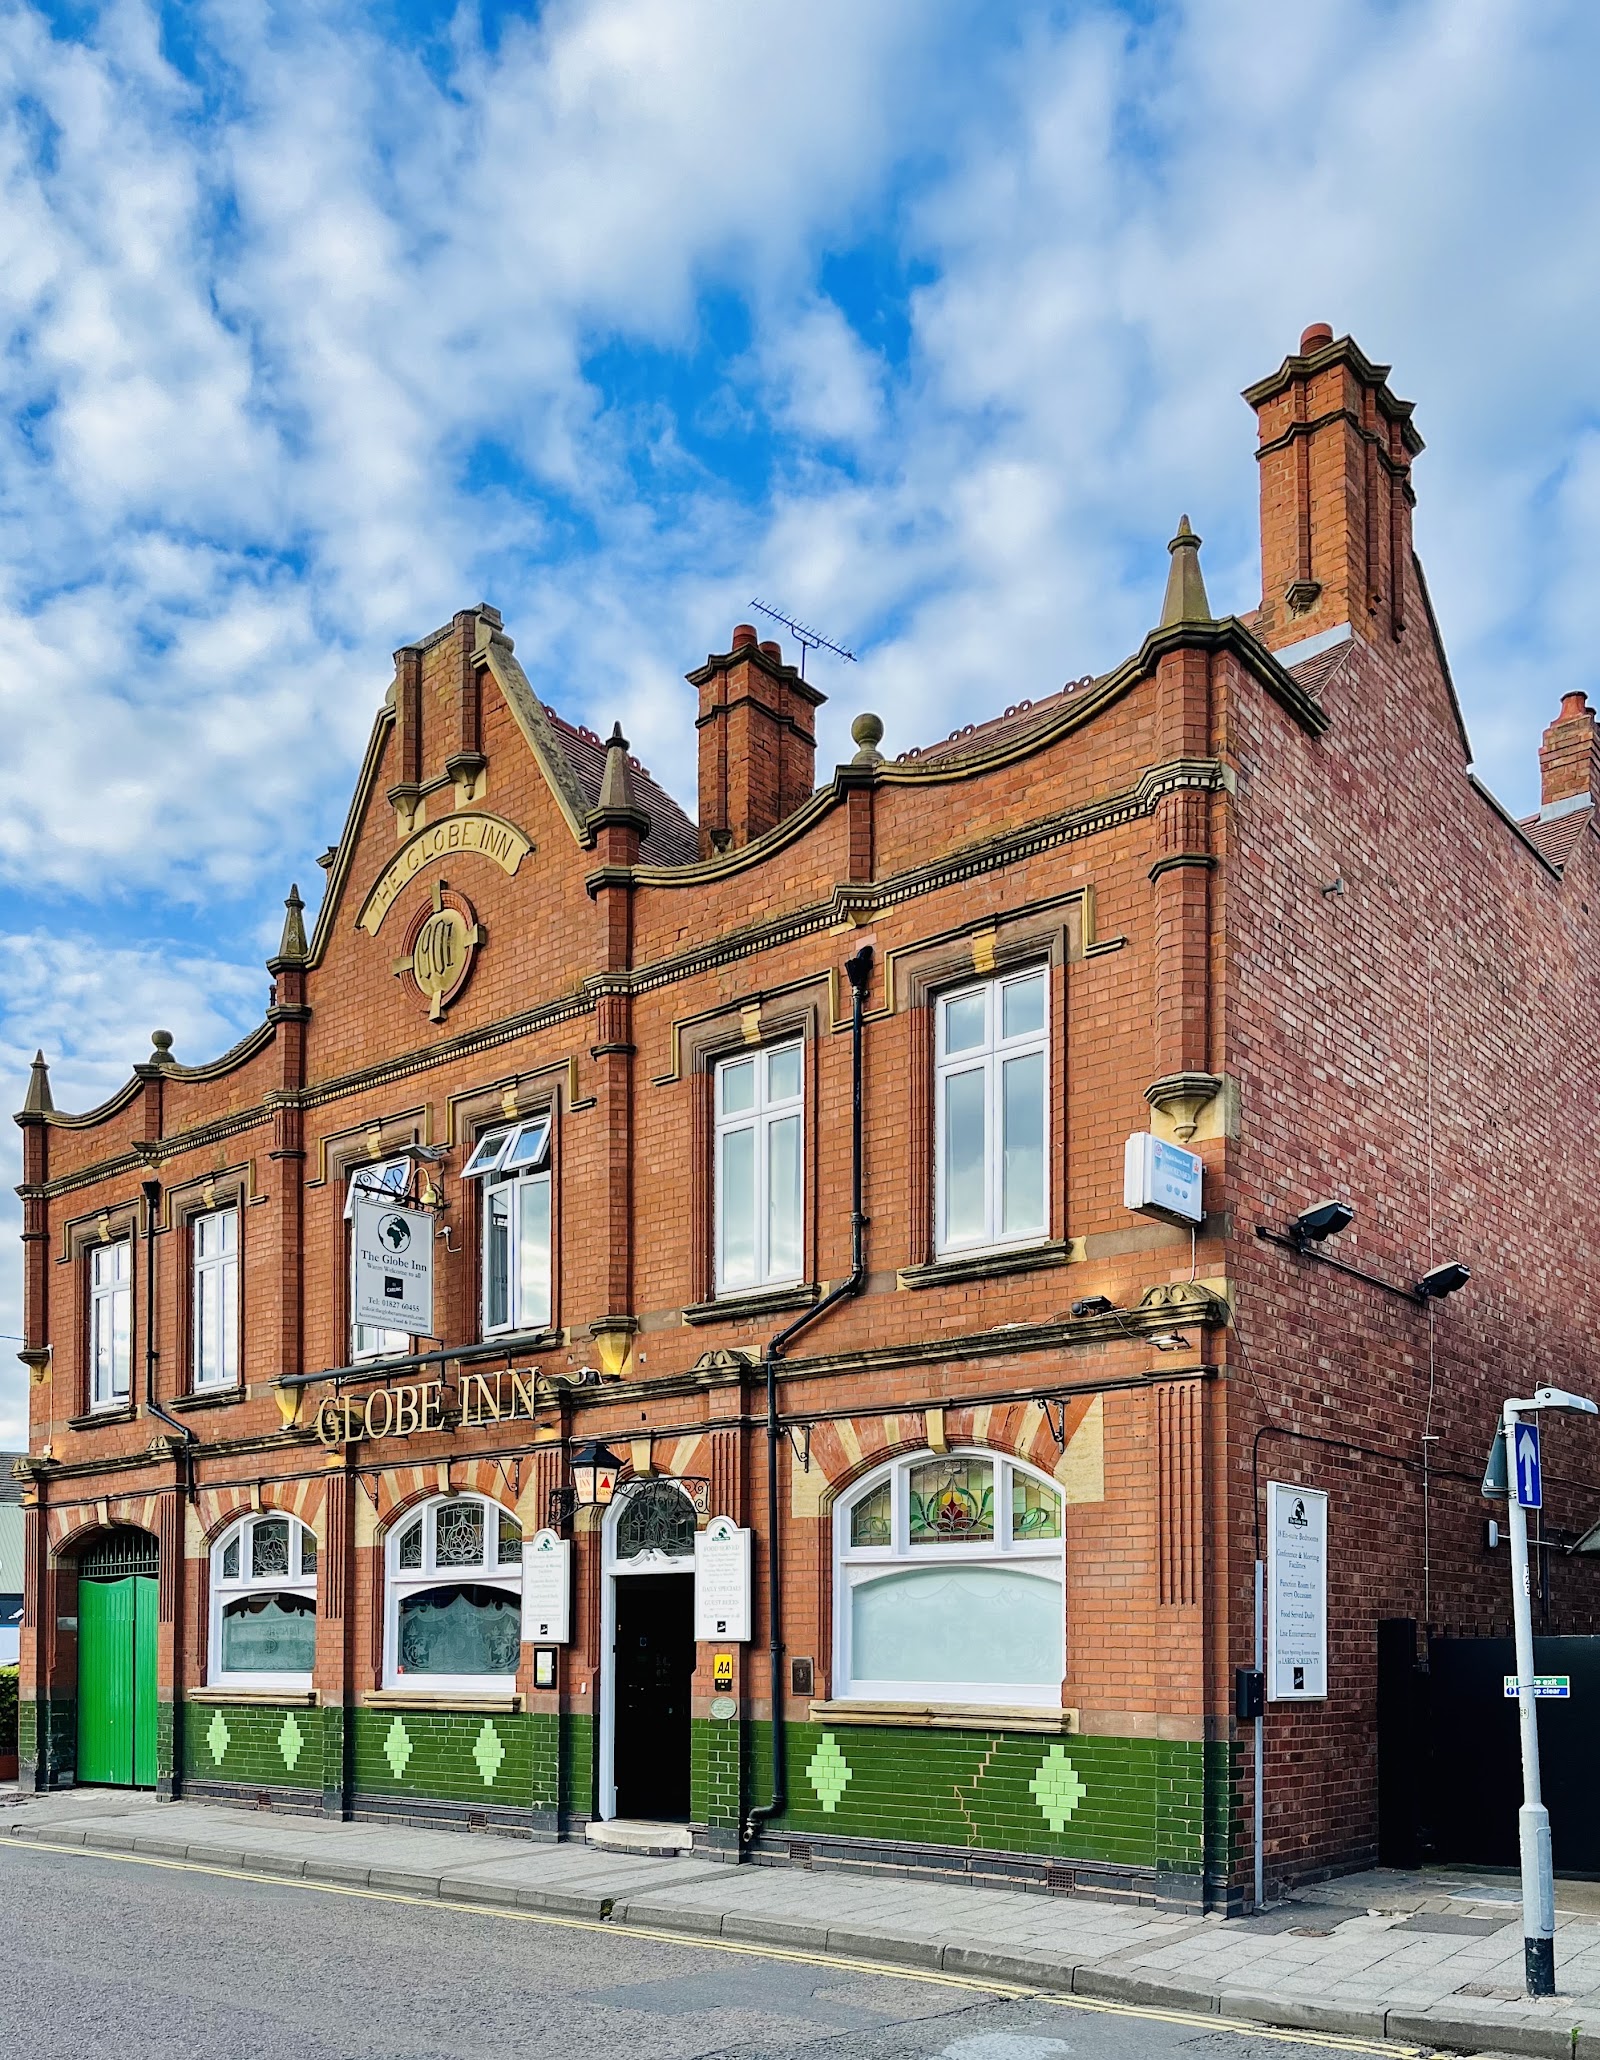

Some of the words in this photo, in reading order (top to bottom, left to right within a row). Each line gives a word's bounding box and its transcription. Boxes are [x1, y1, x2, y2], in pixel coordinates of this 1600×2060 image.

[369, 866, 403, 918] THE
[407, 821, 475, 871] GLOBE
[480, 823, 514, 861] INN
[361, 1250, 379, 1262] The
[382, 1254, 409, 1268] Globe
[412, 1260, 427, 1272] Inn
[367, 1262, 383, 1271] Warm
[384, 1266, 407, 1276] Welcome
[368, 1296, 380, 1304] Tel:
[382, 1300, 400, 1309] 01827
[402, 1303, 420, 1312] 60455
[316, 1381, 445, 1446] GLOBE
[459, 1366, 540, 1427] INN
[575, 1468, 594, 1478] GLOBE
[579, 1479, 591, 1489] INN
[597, 1487, 613, 1496] Bass
[1299, 1532, 1319, 1542] Bedrooms
[1280, 1579, 1297, 1588] Function
[1297, 1581, 1309, 1589] Room
[1280, 1610, 1291, 1618] Food
[1291, 1610, 1304, 1619] Served
[1304, 1611, 1315, 1621] Daily
[1281, 1657, 1296, 1665] LARGE
[1296, 1657, 1313, 1665] SCREEN
[717, 1661, 730, 1674] AA
[1542, 1678, 1558, 1686] exit
